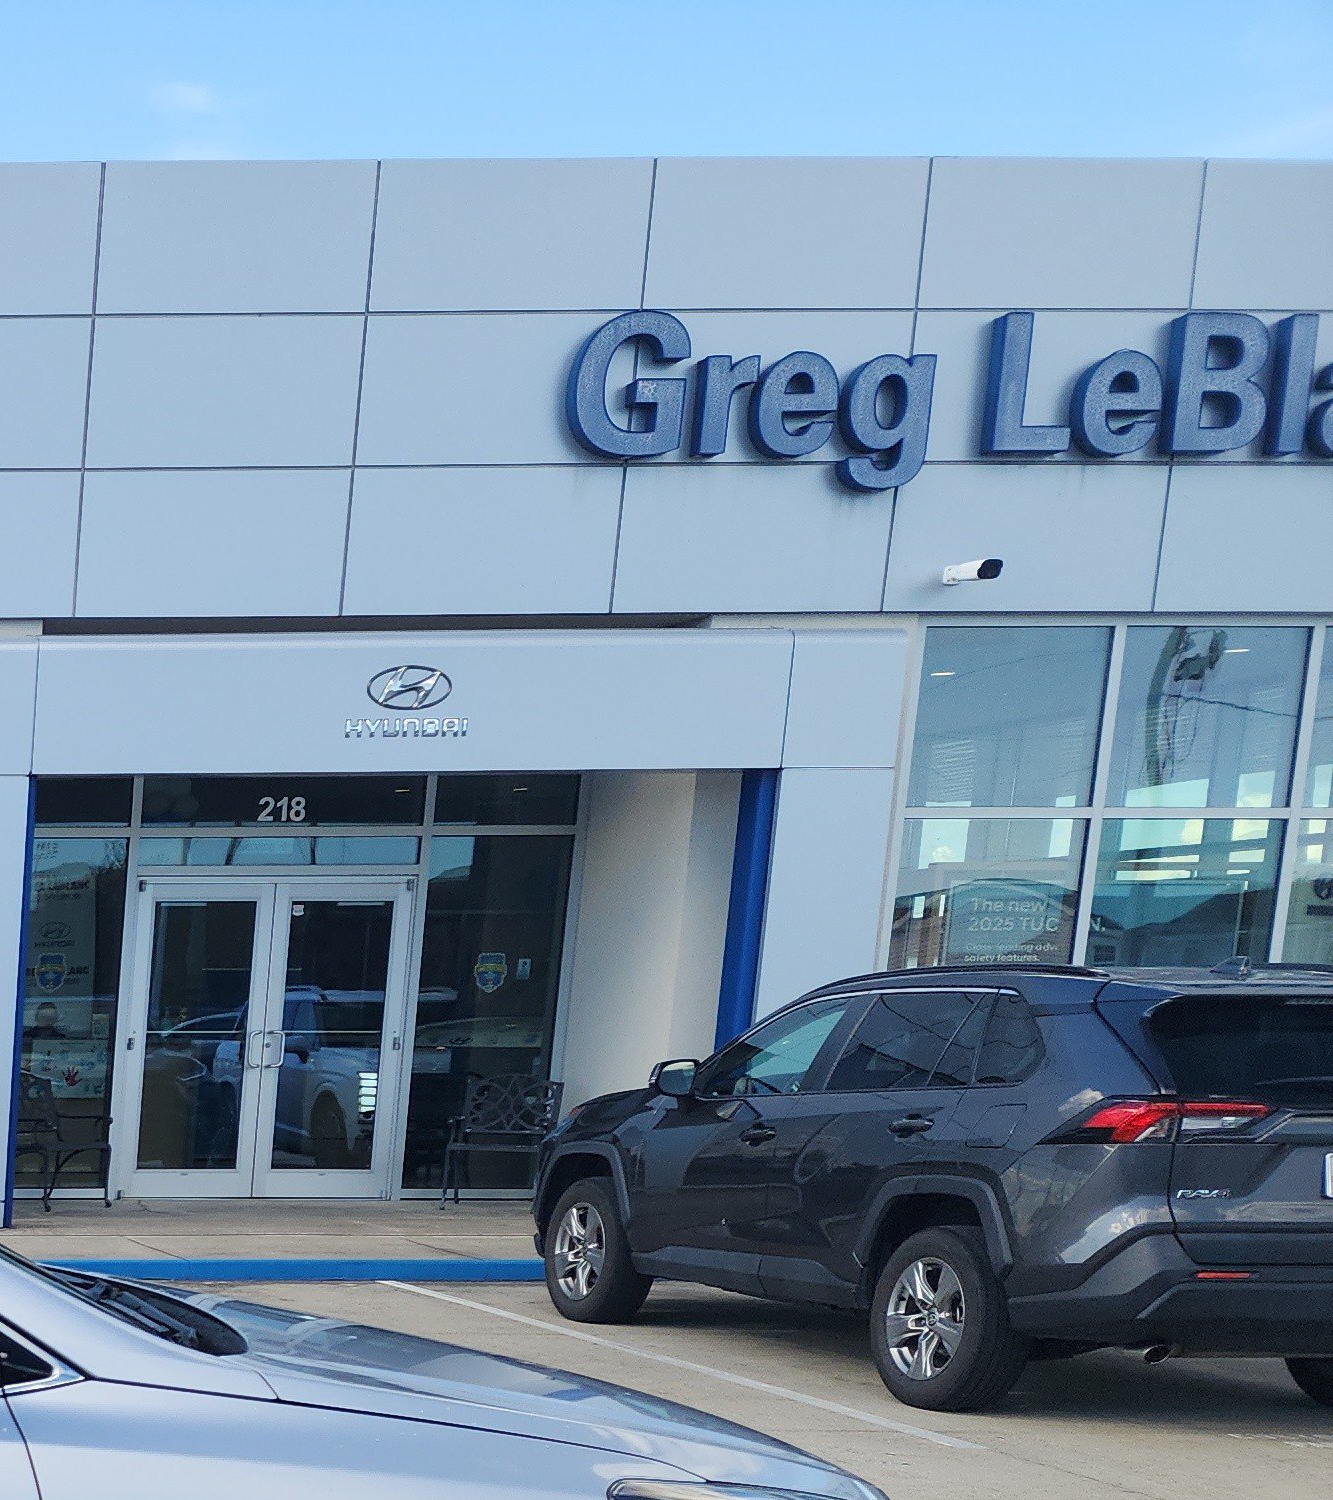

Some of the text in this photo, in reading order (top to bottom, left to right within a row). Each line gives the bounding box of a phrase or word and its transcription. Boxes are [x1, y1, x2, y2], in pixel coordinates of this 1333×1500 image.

[566, 309, 938, 491] Greg
[344, 717, 469, 738] HYUNDAI
[257, 796, 306, 821] 218
[971, 898, 1047, 912] The new
[968, 917, 1014, 931] 2025
[964, 953, 995, 964] safety
[1176, 1188, 1231, 1199] RAV4
